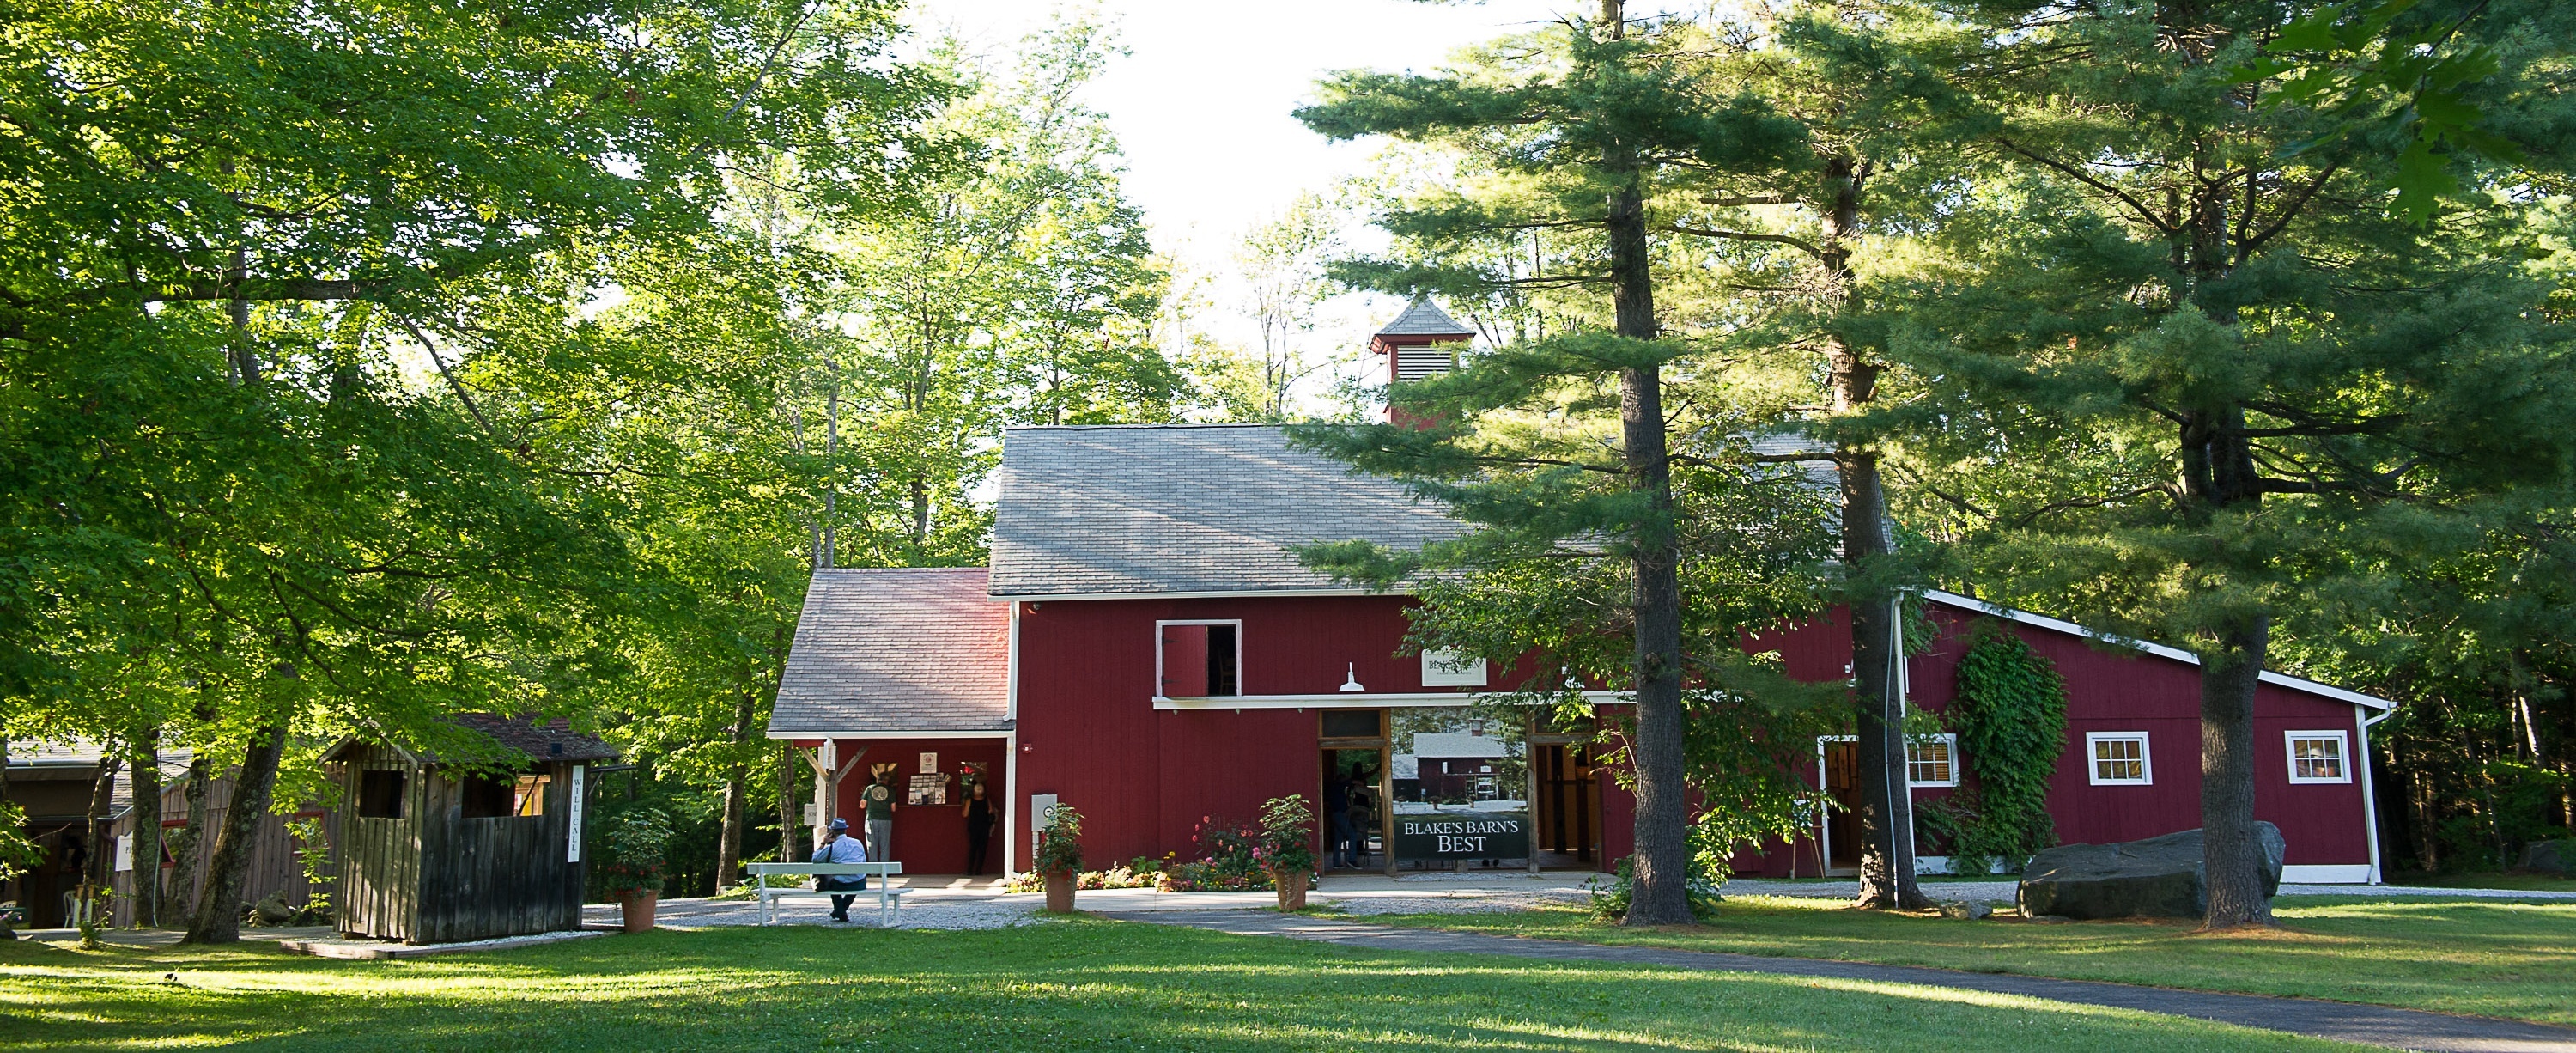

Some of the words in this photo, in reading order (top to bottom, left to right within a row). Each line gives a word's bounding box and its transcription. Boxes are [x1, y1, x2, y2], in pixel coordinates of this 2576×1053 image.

[1405, 822, 1463, 835] BLAKE'S
[1466, 820, 1519, 834] BARN'S
[1437, 835, 1487, 853] BEST
